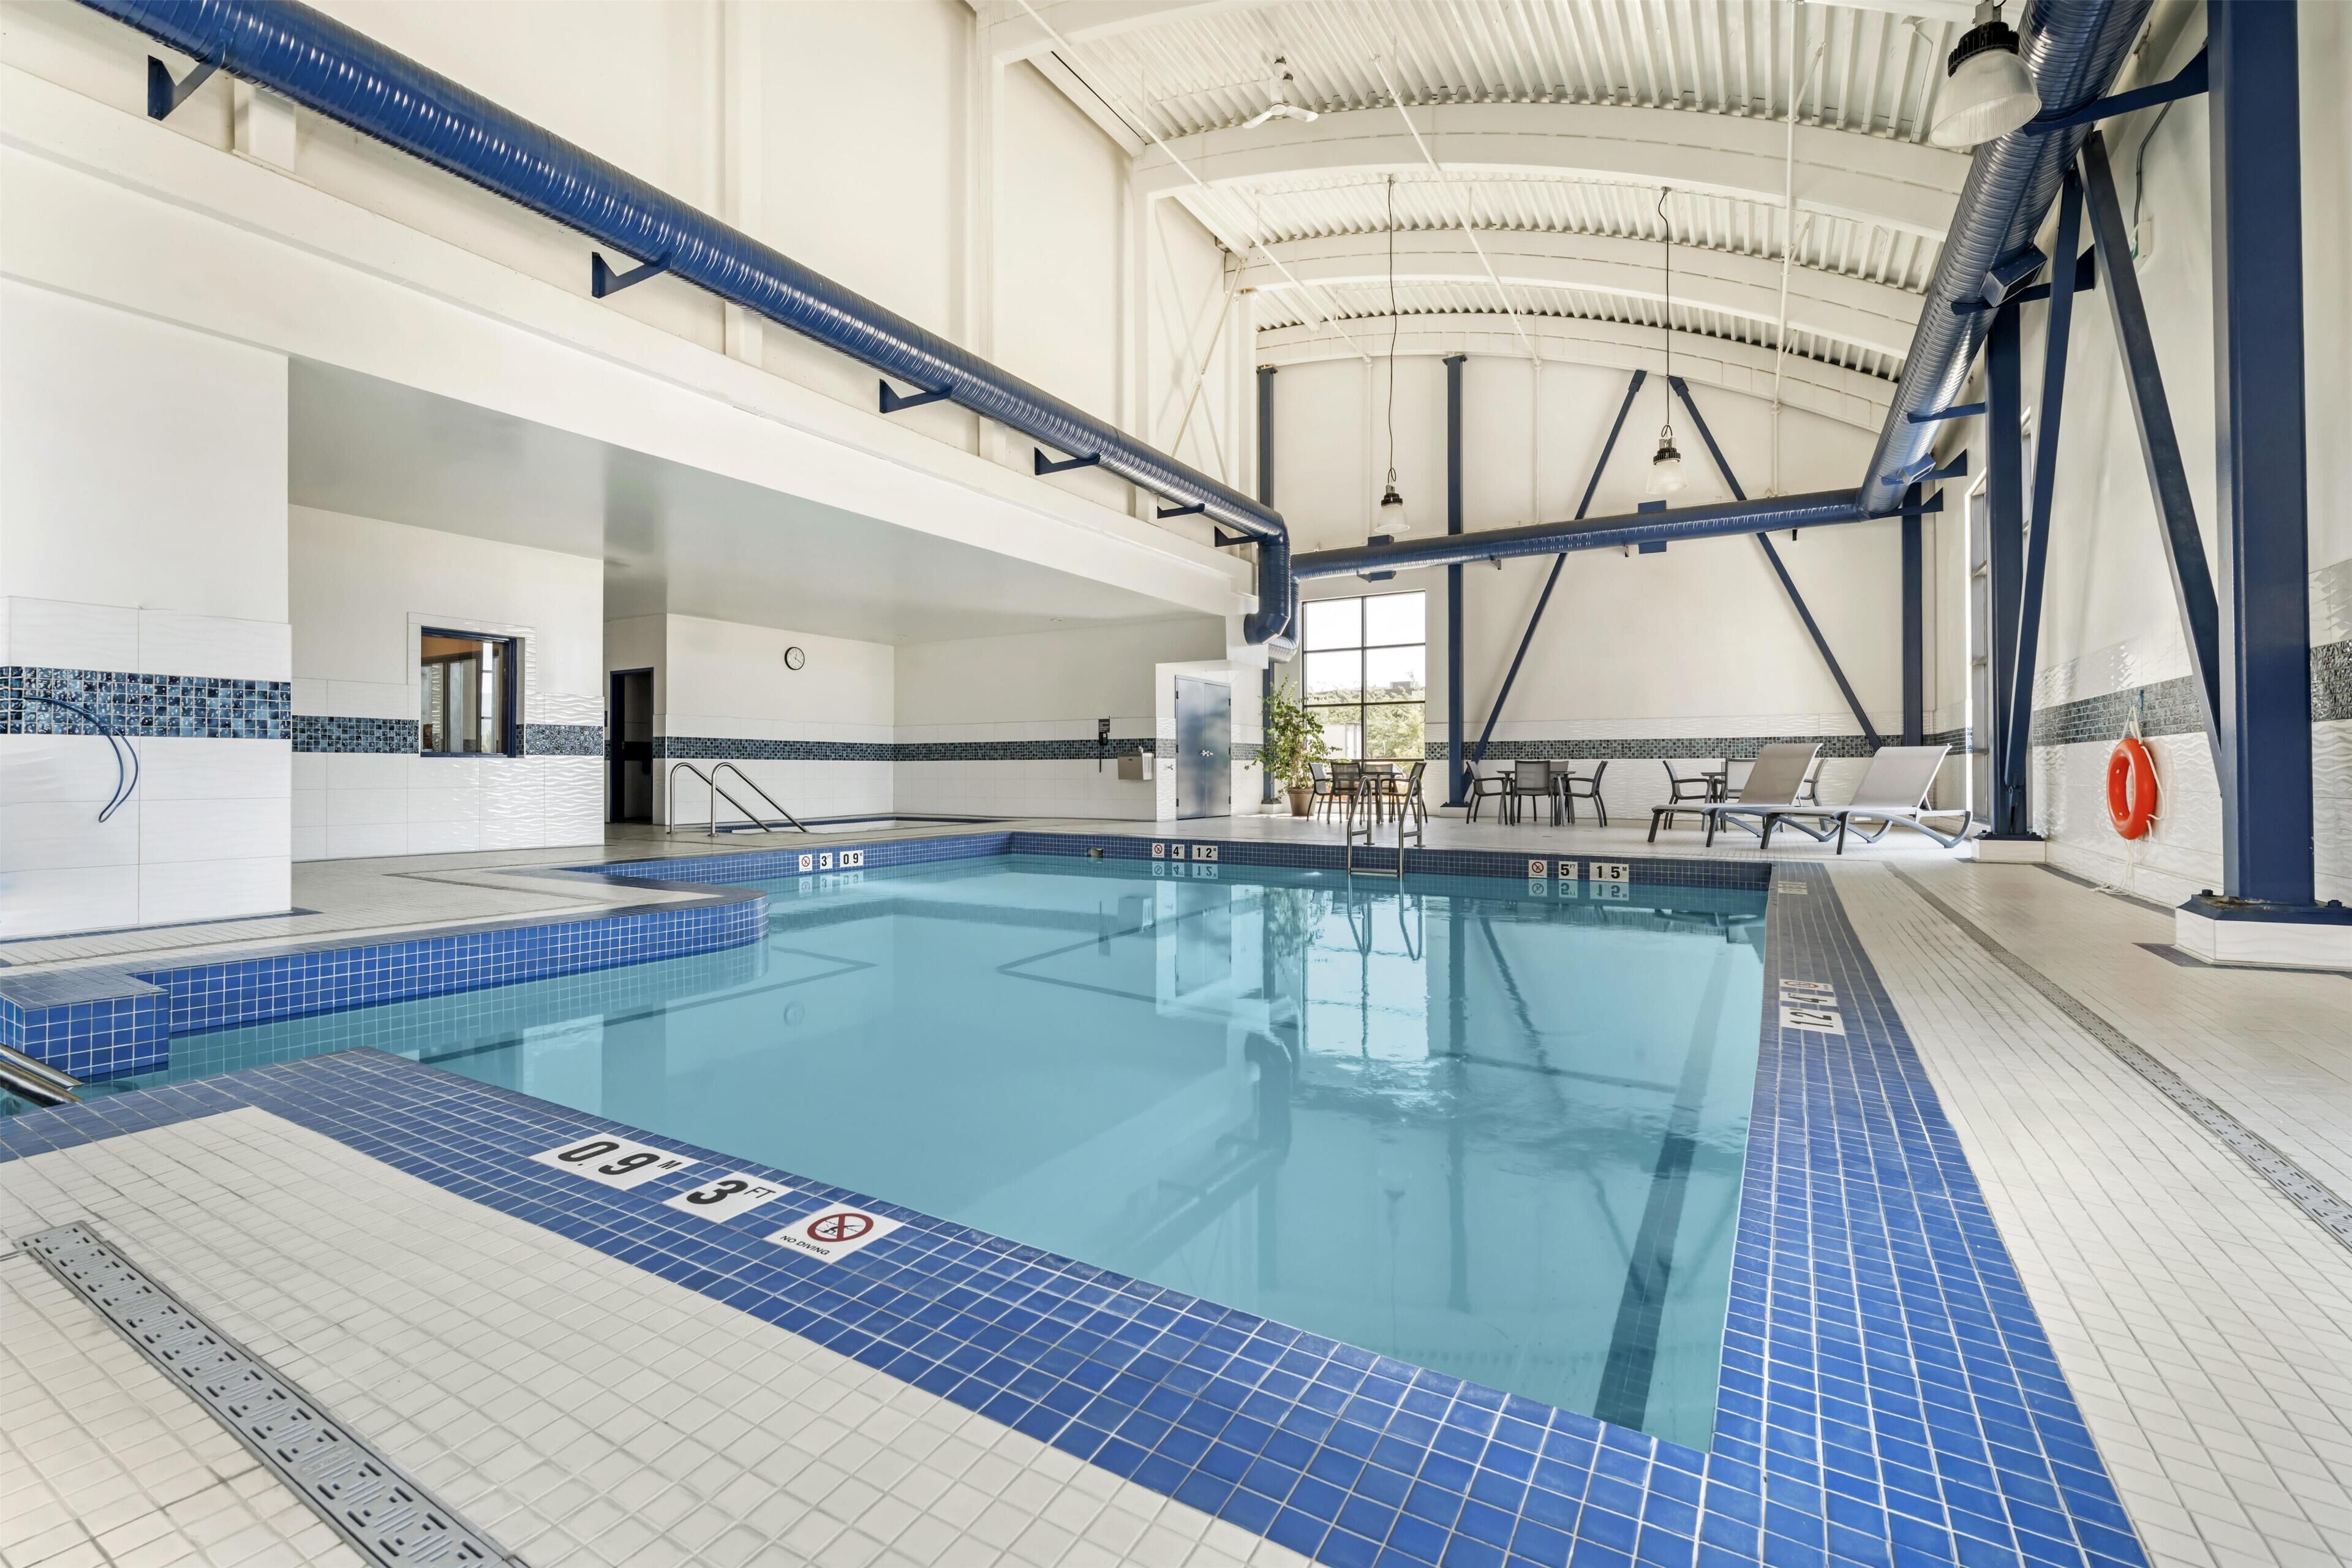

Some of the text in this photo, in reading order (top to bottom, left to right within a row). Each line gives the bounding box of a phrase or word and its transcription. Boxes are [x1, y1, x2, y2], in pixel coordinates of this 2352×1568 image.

[1173, 846, 1180, 856] 4
[821, 856, 827, 866] 3
[1560, 864, 1570, 876] 5
[557, 1141, 683, 1175] 0.9 M
[686, 1180, 777, 1204] 3 FT
[796, 1241, 830, 1255] DIVING
